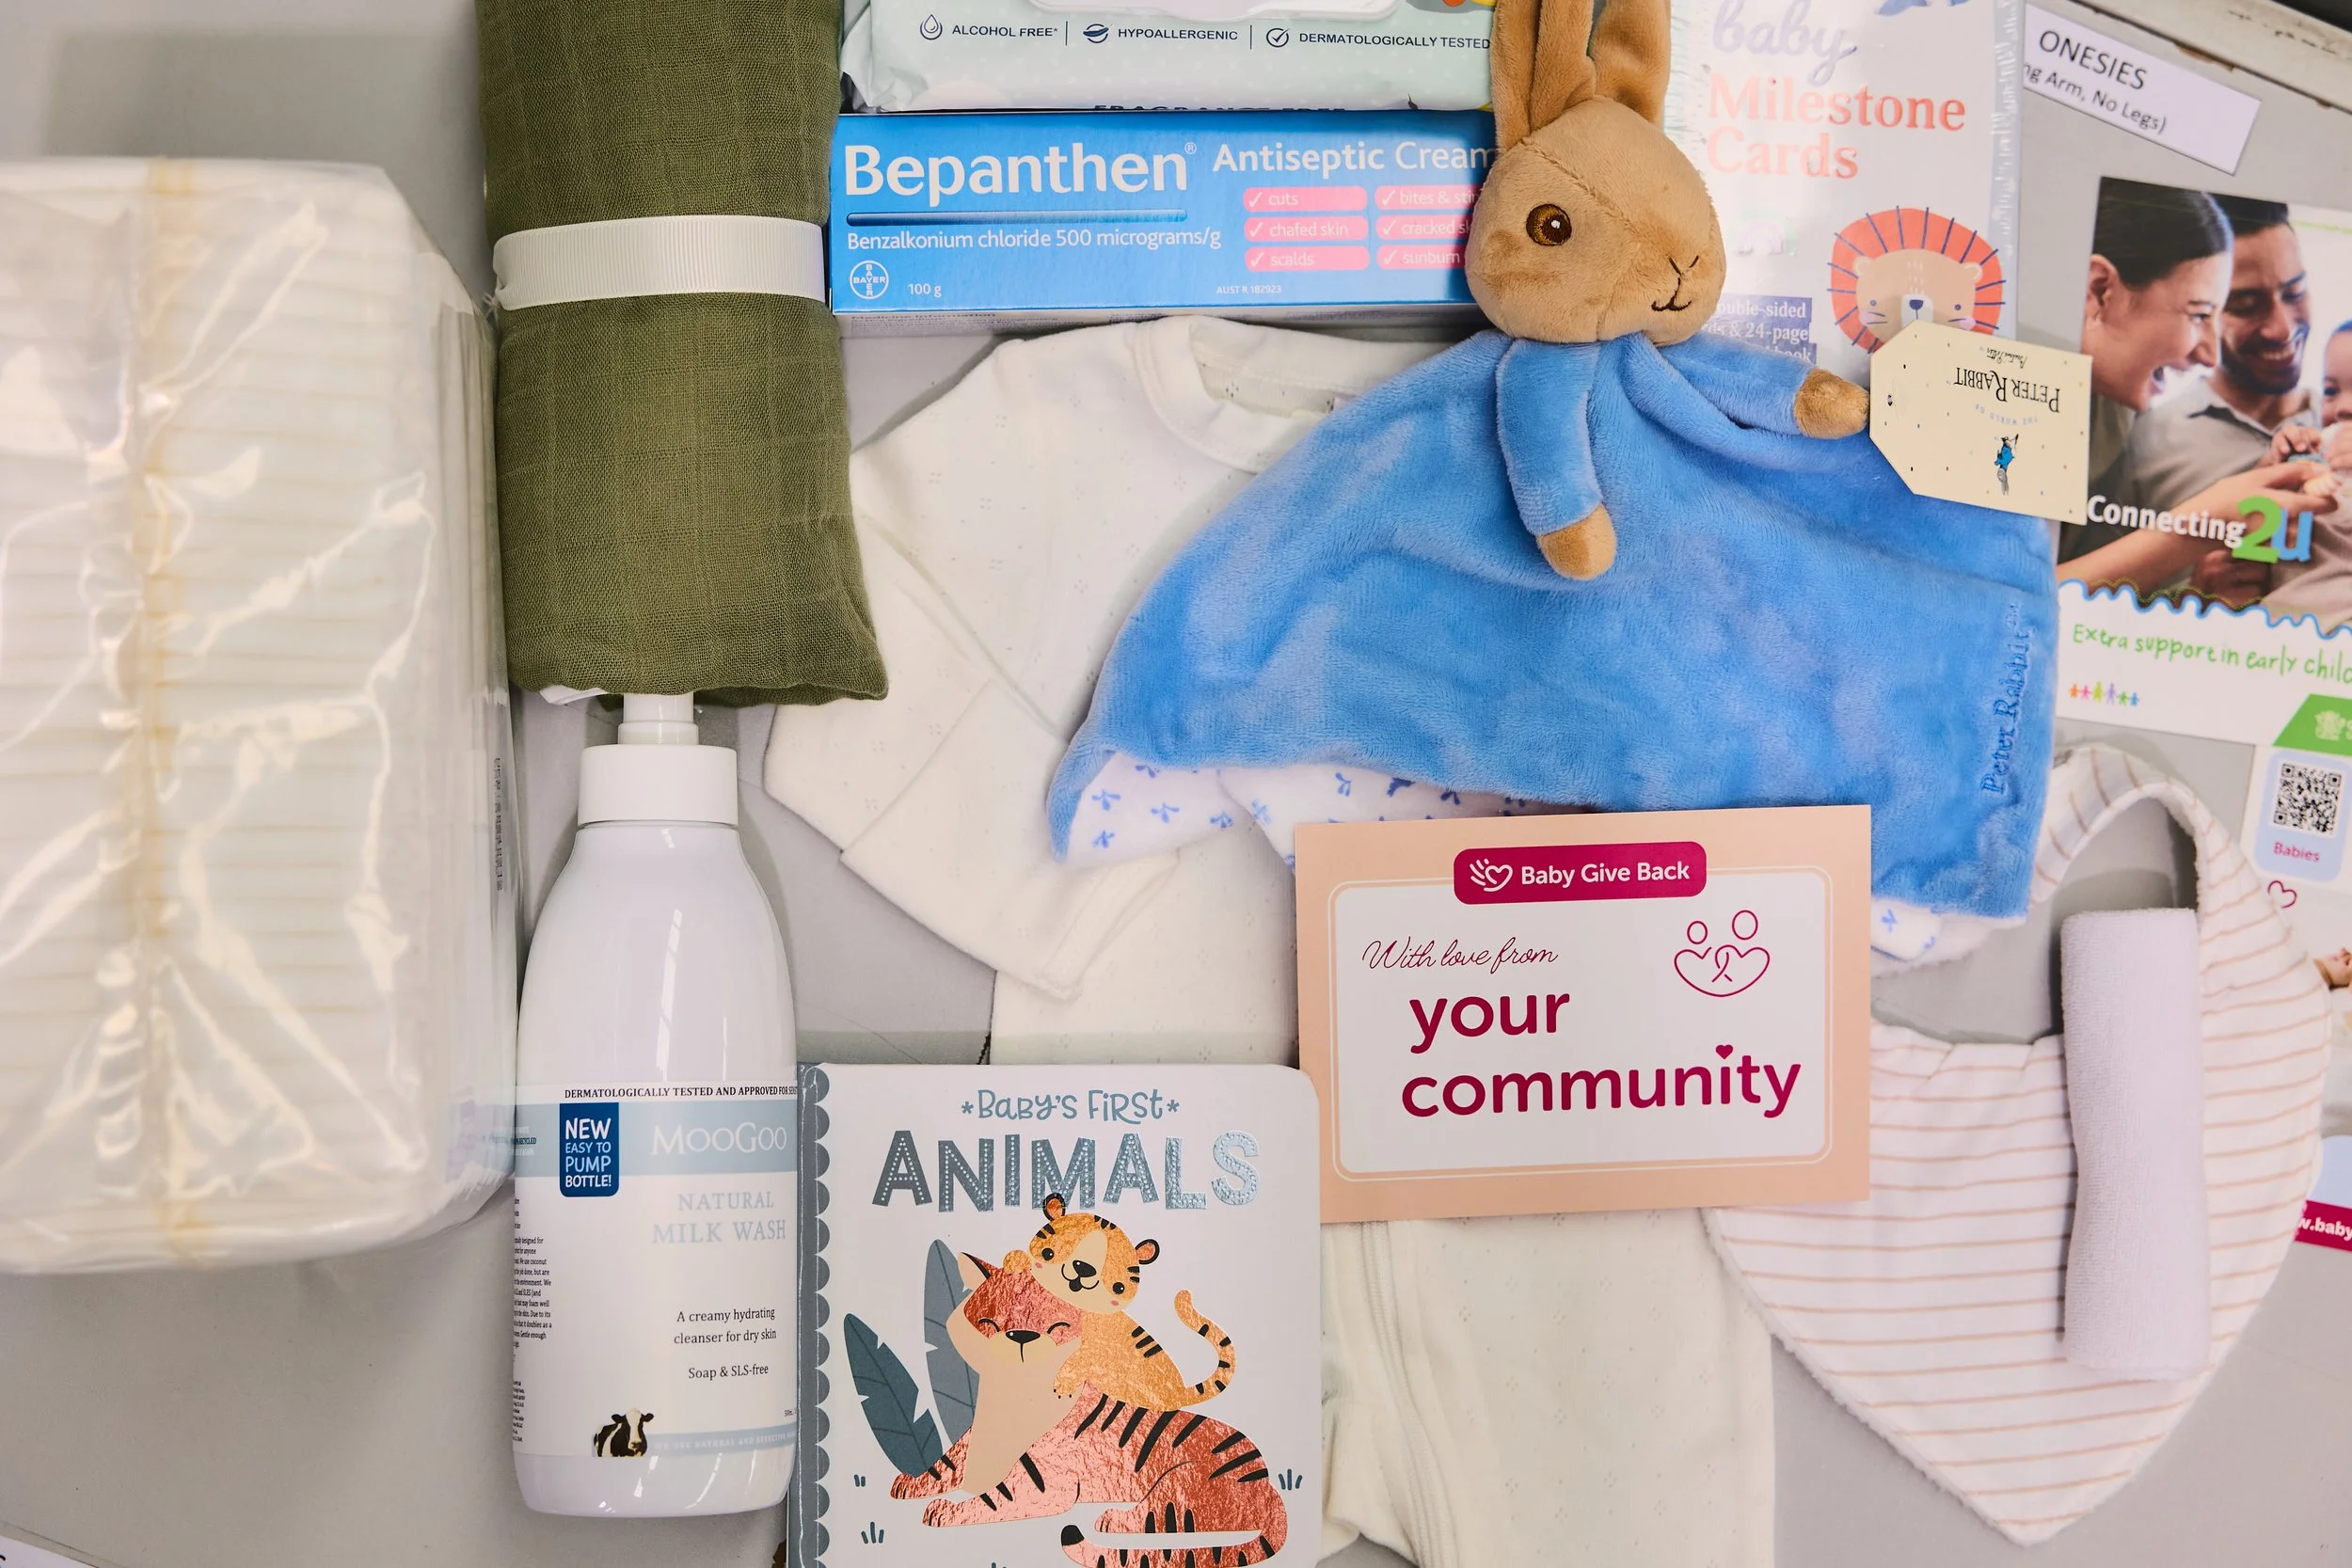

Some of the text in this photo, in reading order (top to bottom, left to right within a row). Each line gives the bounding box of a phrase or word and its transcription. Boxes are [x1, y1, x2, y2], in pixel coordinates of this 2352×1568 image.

[952, 24, 1016, 37] ALCOHOL
[1118, 28, 1238, 40] HYPOALLERGENIC
[1299, 33, 1490, 49] DERMATOLOGICALLY TESTED
[1712, 0, 1857, 87] baby
[2039, 30, 2148, 91] ONESIES
[1708, 72, 1965, 132] Milestone
[2044, 71, 2086, 103] Arm,
[2092, 90, 2118, 113] No
[2122, 107, 2168, 136] Legs)
[1213, 141, 1385, 180] Antiseptic
[1706, 125, 1859, 179] Cards
[1268, 193, 1298, 206] cuts
[1400, 190, 1434, 204] bites
[1438, 191, 1449, 204] &
[848, 227, 1221, 250] Benzalkonium chloride 500 micrograms/g
[1269, 221, 1317, 237] chafed
[1320, 221, 1348, 236] skin
[1401, 219, 1455, 234] cracked
[1271, 250, 1460, 266] scalds sunburn
[909, 284, 942, 297] 100 g
[1217, 284, 1282, 294] AUST R 182923
[1717, 300, 1806, 318] ouble-sided
[1730, 322, 1741, 337] &
[1745, 322, 1808, 345] 24-page
[1953, 367, 2060, 414] PETER RABBIT
[2087, 495, 2248, 549] Connecting
[2073, 623, 2128, 649] Extra
[2135, 635, 2217, 661] support
[2221, 644, 2239, 666] in
[2246, 644, 2296, 675] early
[1993, 628, 2030, 721] Rabbit
[1979, 723, 2016, 796] Peter
[2273, 841, 2320, 863] Babies
[1520, 861, 1691, 889] Baby Give Back
[1362, 936, 1559, 974] With love from
[1409, 992, 1570, 1054] your
[564, 1086, 670, 1099] DERMATOLOGICALLY
[673, 1086, 713, 1097] TESTED
[716, 1085, 737, 1096] AND
[739, 1085, 778, 1096] APPROVED
[1402, 1044, 1802, 1119] community
[565, 1117, 612, 1141] NEW
[565, 1141, 612, 1154] EASY TO
[565, 1156, 612, 1173] PUMP
[871, 1130, 1261, 1212] ANIMALS
[565, 1174, 612, 1188] BOTTLE!
[677, 1191, 774, 1212] NATURAL
[651, 1219, 787, 1244] MILK WASH
[676, 1307, 775, 1324] A creamy hydrating
[674, 1328, 777, 1345] cleanser for dry skin
[688, 1364, 769, 1382] Soap & SLS-free
